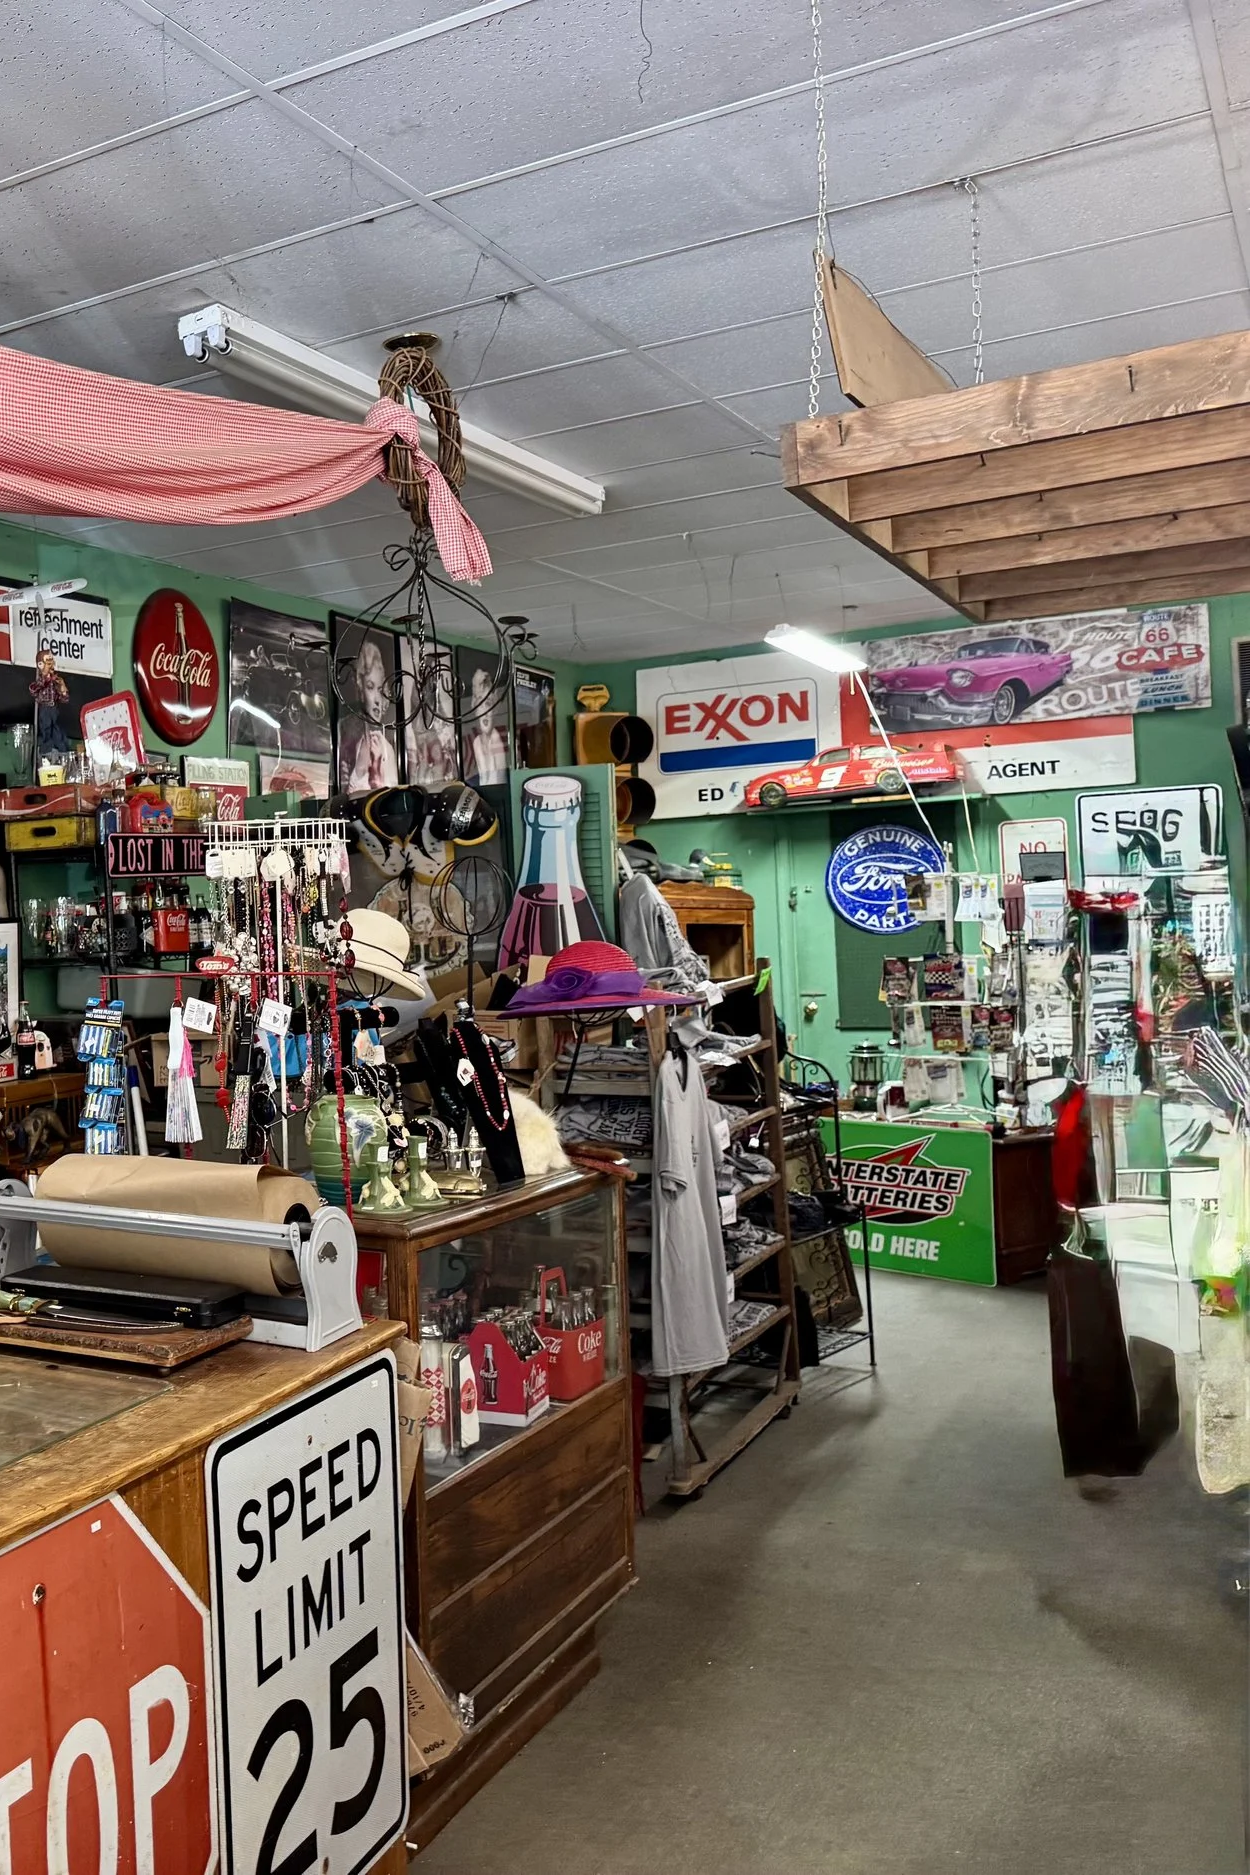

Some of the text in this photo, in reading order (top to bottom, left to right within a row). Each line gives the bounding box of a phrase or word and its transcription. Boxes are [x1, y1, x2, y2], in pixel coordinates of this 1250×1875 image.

[1143, 613, 1168, 622] ROUTE
[1145, 628, 1170, 643] 66
[41, 637, 85, 660] center
[1121, 644, 1198, 667] CAFE
[150, 643, 213, 687] Coca-Cola
[1139, 673, 1184, 684] BREAKFAST
[1143, 684, 1183, 694] LUNCH
[1034, 679, 1142, 717] ROUTE
[665, 690, 810, 742] EXXON
[187, 763, 248, 782] FILLING STATION
[817, 766, 848, 790] 9
[987, 759, 1060, 780] AGENT
[698, 788, 724, 802] ED
[119, 838, 152, 872] LOST
[162, 838, 174, 870] IN
[844, 830, 924, 857] GENUINE
[198, 961, 229, 971] Tom's
[827, 1159, 961, 1191] NTERSTATE
[890, 1236, 940, 1262] HERE
[577, 1330, 602, 1354] Coke
[236, 1427, 381, 1583] SPEED
[255, 1530, 371, 1687] LIMIT
[247, 1627, 386, 1875] 25
